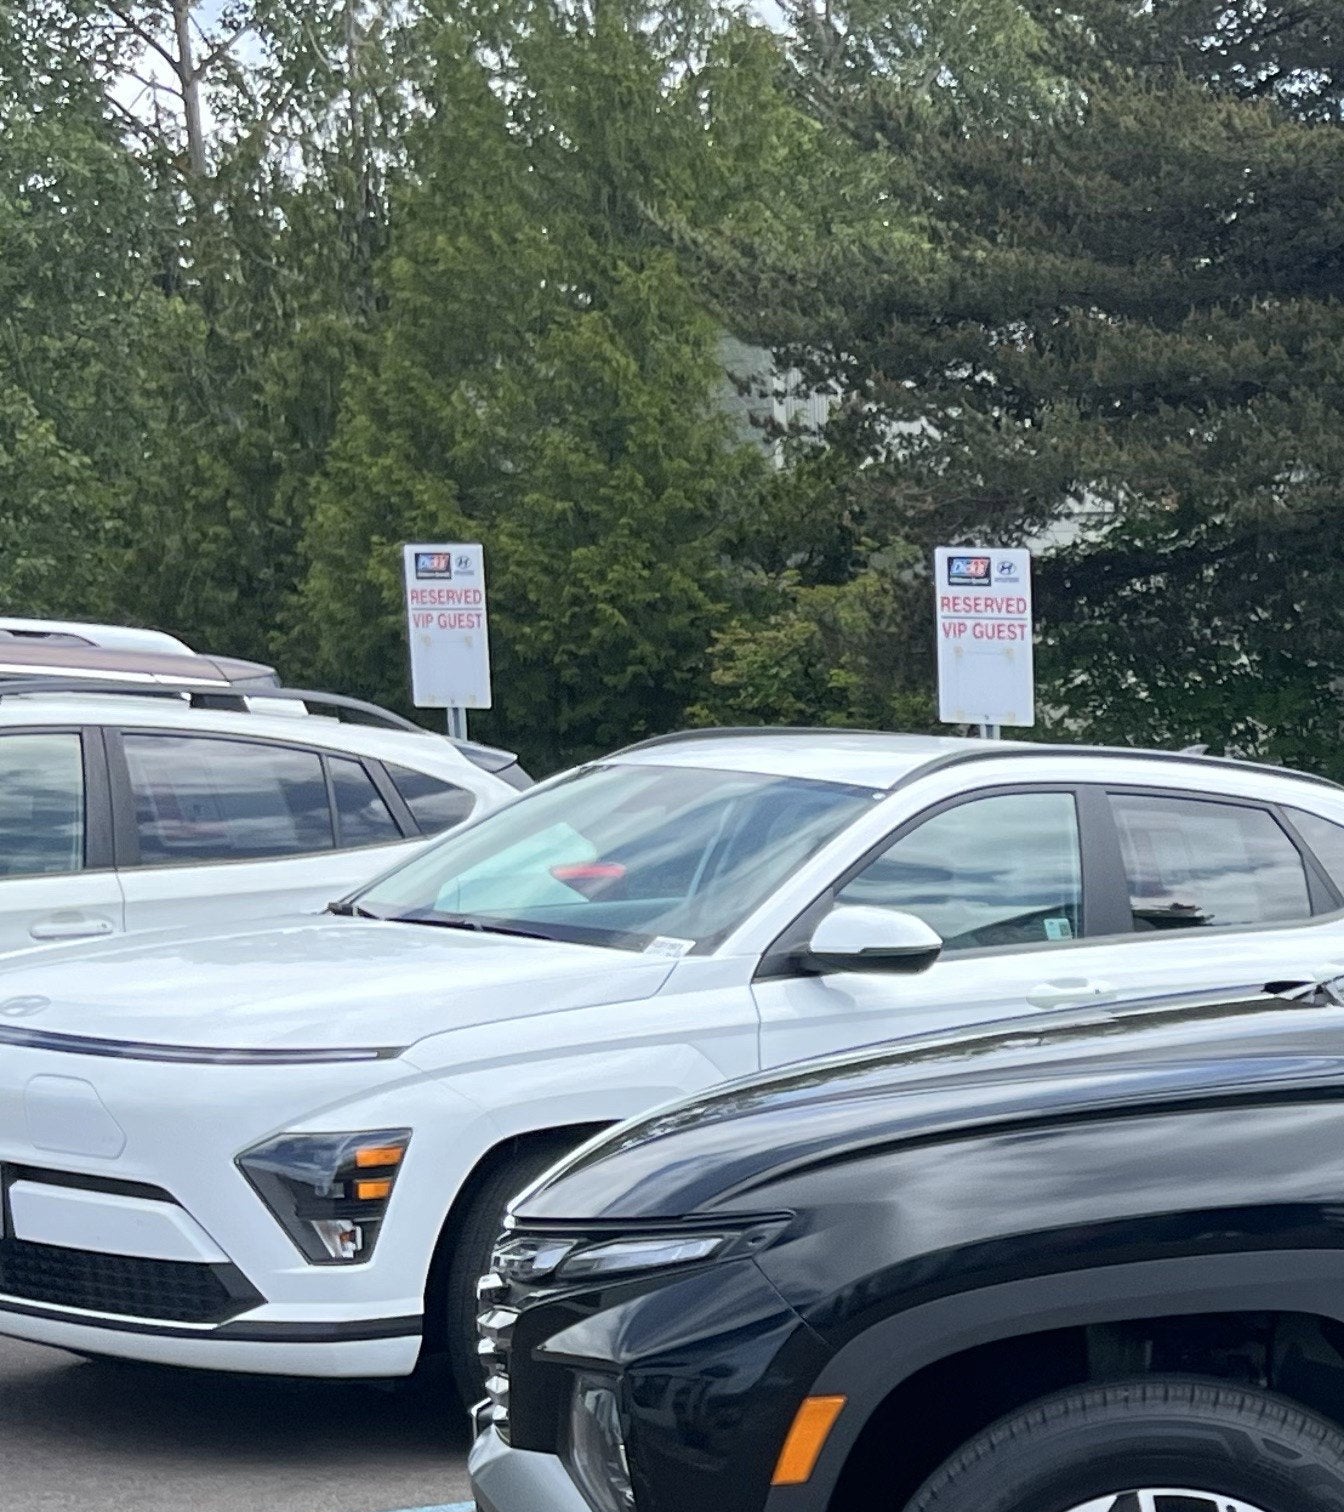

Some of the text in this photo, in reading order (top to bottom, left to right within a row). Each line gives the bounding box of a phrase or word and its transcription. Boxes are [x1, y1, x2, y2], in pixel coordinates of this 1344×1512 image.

[411, 589, 482, 605] RESERVED
[940, 596, 1027, 614] RESERVED
[413, 613, 482, 630] VIP GUEST
[942, 622, 1027, 641] VIP GUEST
